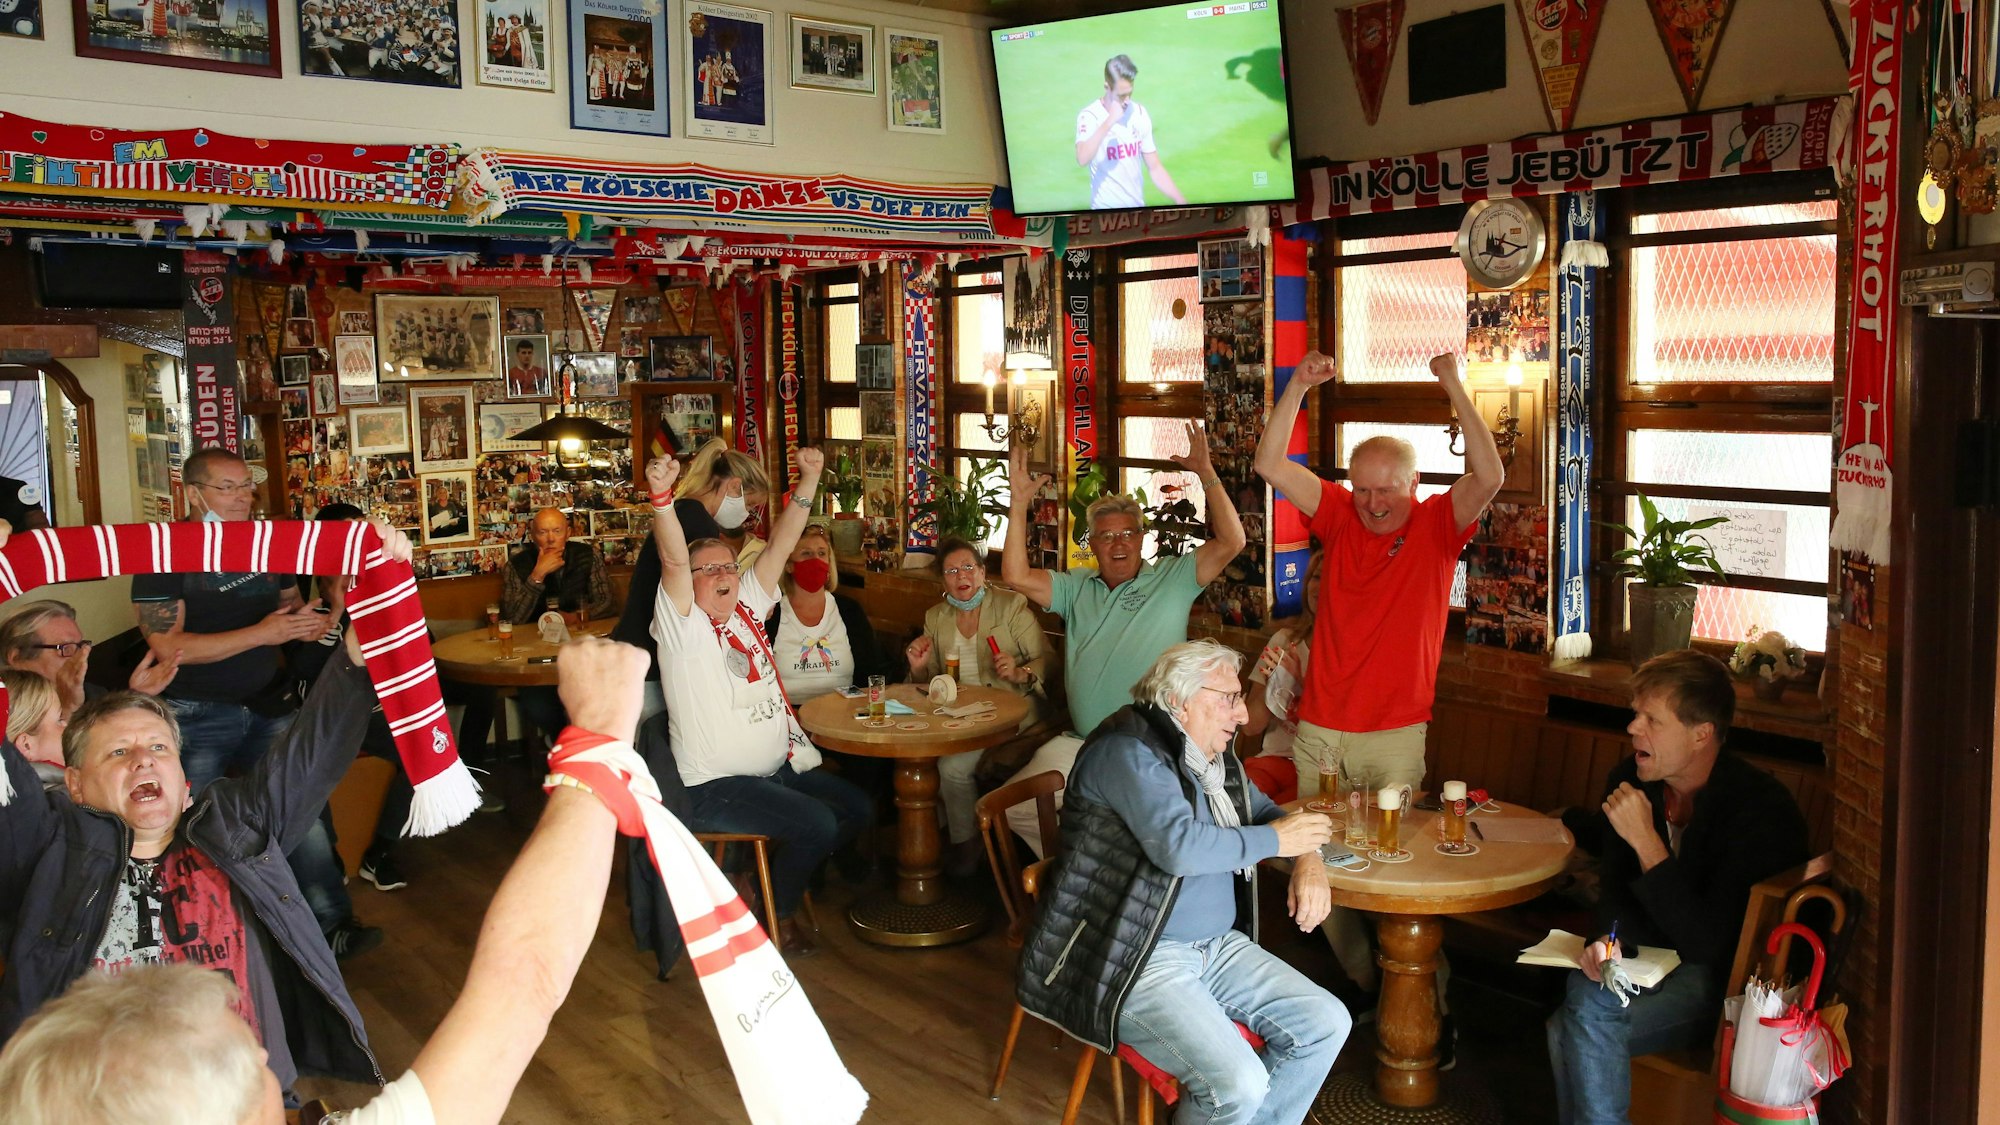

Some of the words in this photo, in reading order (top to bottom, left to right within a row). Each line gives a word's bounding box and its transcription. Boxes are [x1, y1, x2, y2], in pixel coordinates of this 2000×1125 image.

[113, 139, 169, 165] EM
[166, 160, 287, 194] VEEDEL
[425, 149, 449, 208] 2020
[1331, 174, 1363, 205] IN
[1366, 156, 1490, 200] KÖLLE
[1496, 131, 1709, 186] JEBÜTZT
[508, 169, 569, 194] MER
[581, 171, 709, 202] KÖLSCHE
[713, 177, 828, 214] DANZE
[830, 189, 861, 211] US
[869, 193, 917, 219] DER
[920, 200, 972, 220] REIN
[1097, 210, 1144, 233] WAT
[188, 336, 211, 347] KÖLN
[189, 326, 231, 336] FAN-CLUB
[782, 327, 799, 374] KÖLN
[1845, 452, 1862, 467] HE
[1558, 522, 1566, 551] WELT
[129, 885, 199, 951] FC
